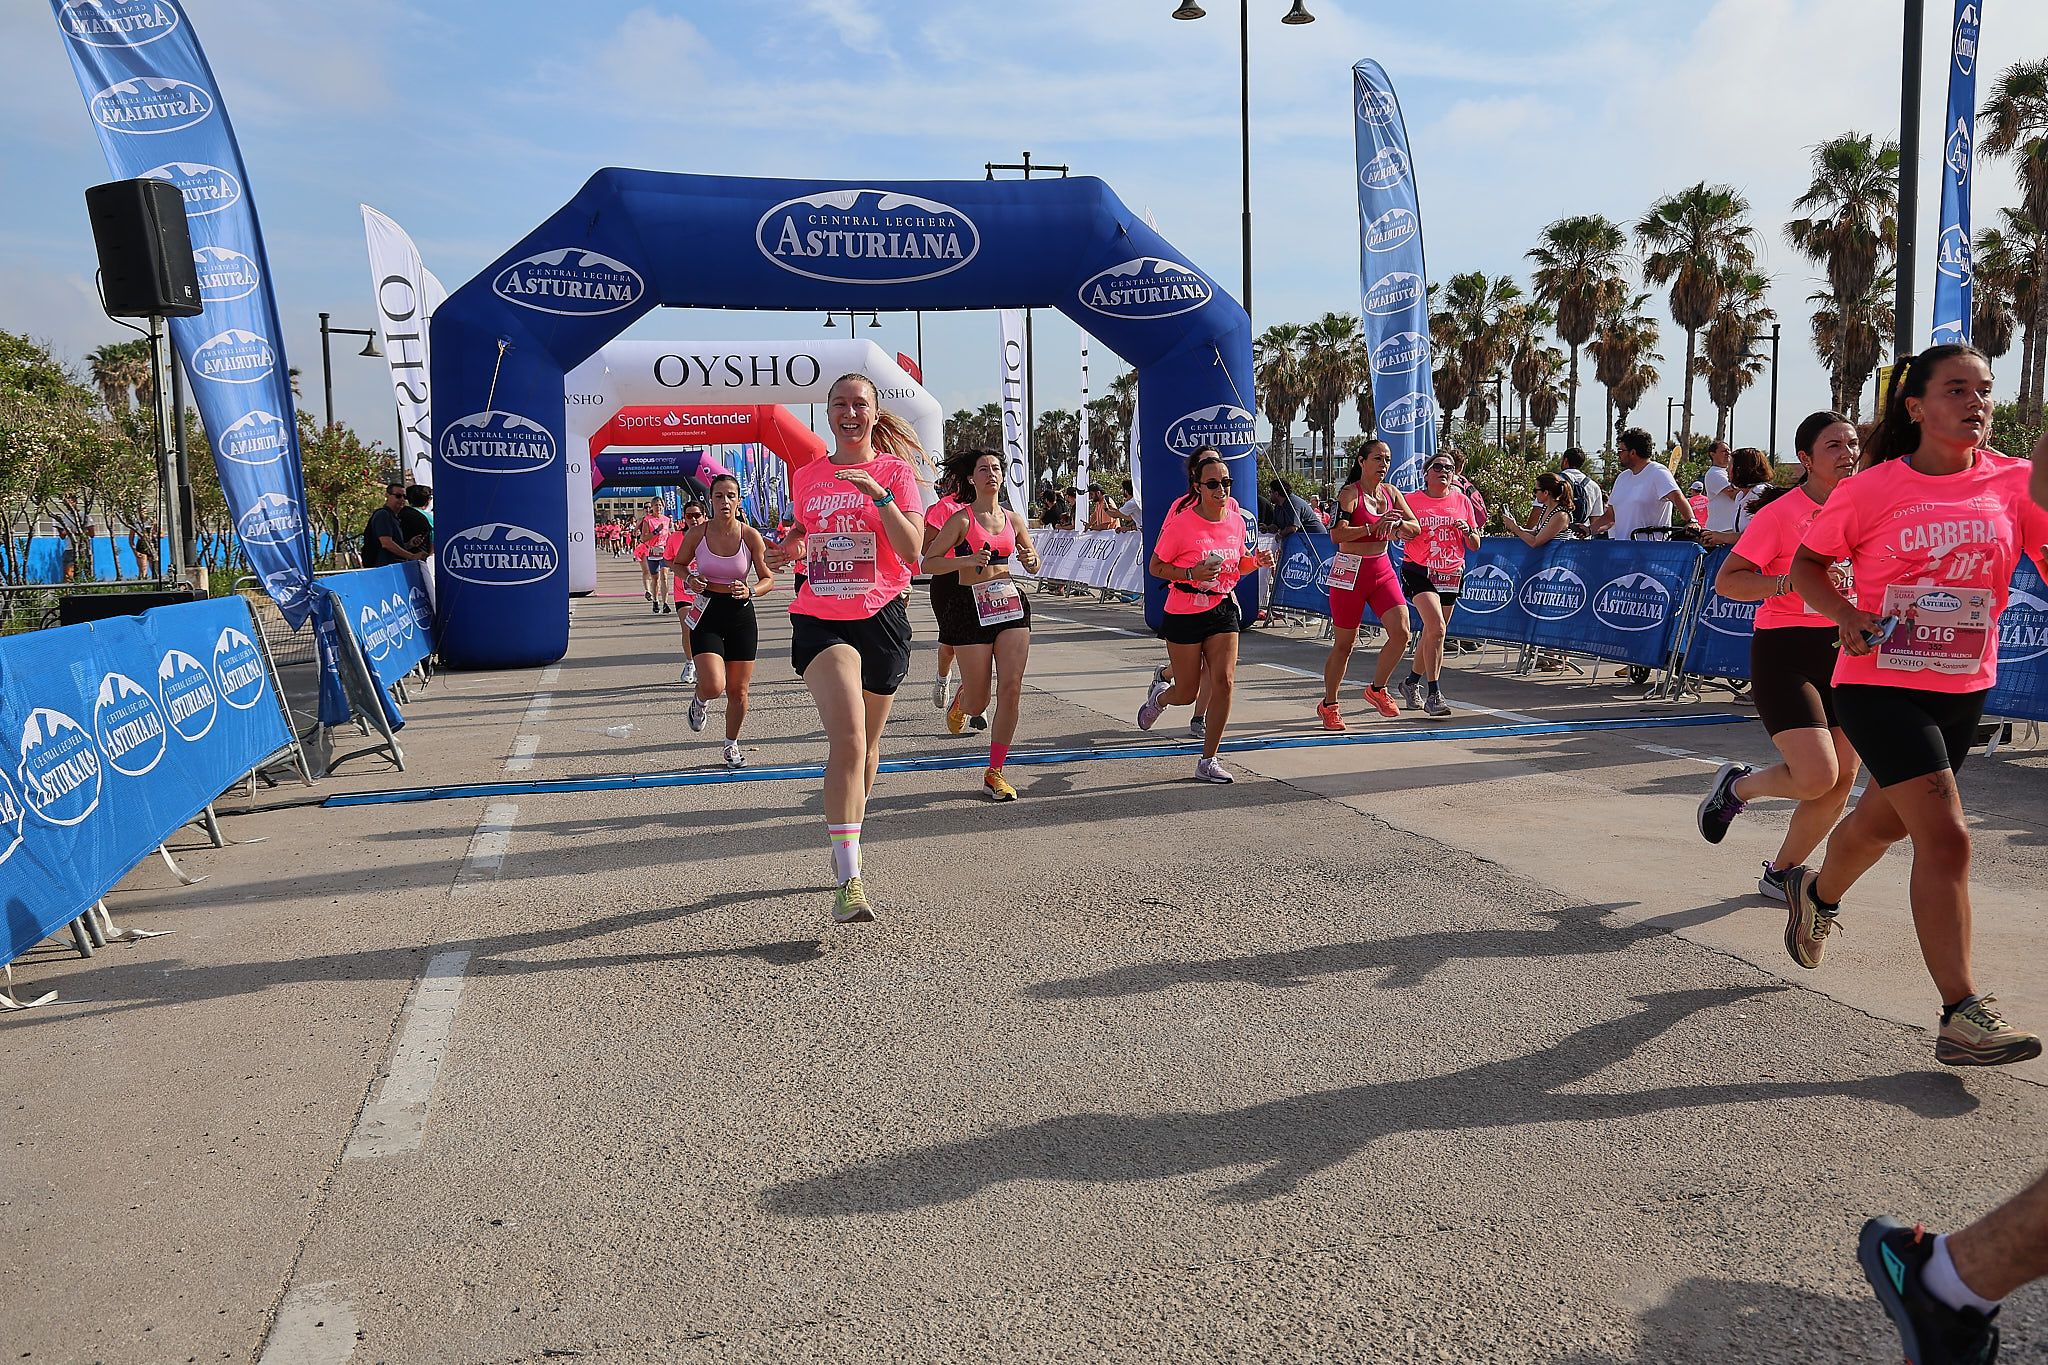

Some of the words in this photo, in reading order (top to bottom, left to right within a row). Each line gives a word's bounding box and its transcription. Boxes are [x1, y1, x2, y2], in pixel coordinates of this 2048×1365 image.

[808, 214, 879, 226] CENTRAL
[886, 216, 956, 228] LECHERA
[773, 215, 964, 259] ASTURIANA
[528, 268, 579, 278] CENTRAL
[582, 271, 632, 282] LECHERA
[1110, 277, 1156, 288] CENTRAL
[502, 270, 633, 301] ASTURIANA
[1090, 284, 1206, 306] ASTURIANA
[653, 354, 821, 387] OYSHO
[564, 394, 604, 405] YSHO
[878, 388, 915, 399] YSHO
[618, 414, 661, 429] Sports
[682, 413, 751, 426] Santander
[460, 431, 503, 439] CENTRAL
[507, 432, 547, 442] LECHERA
[445, 433, 550, 460] ASTURIANA
[806, 493, 864, 512] CARRERA
[1894, 503, 1935, 519] OYSHO
[1420, 516, 1455, 527] CARRERA
[1900, 520, 1998, 552] CARRERA
[509, 544, 549, 552] LECHERA
[449, 545, 552, 570] ASTURIANA
[828, 561, 854, 572] 016
[1842, 576, 1854, 588] 16
[1461, 581, 1507, 601] ASTURIANA
[1523, 584, 1579, 608] ASTURIANA
[1597, 591, 1663, 620] ASTURIANA
[1702, 594, 1759, 620] ASTUR
[1920, 598, 1959, 608] ASTURIANA
[1916, 626, 1955, 642] 016
[1890, 648, 1914, 656] CARRERA
[1889, 658, 1924, 667] OYSHO
[165, 683, 215, 725] ASTURIANA
[104, 711, 163, 760] ASTURIANA
